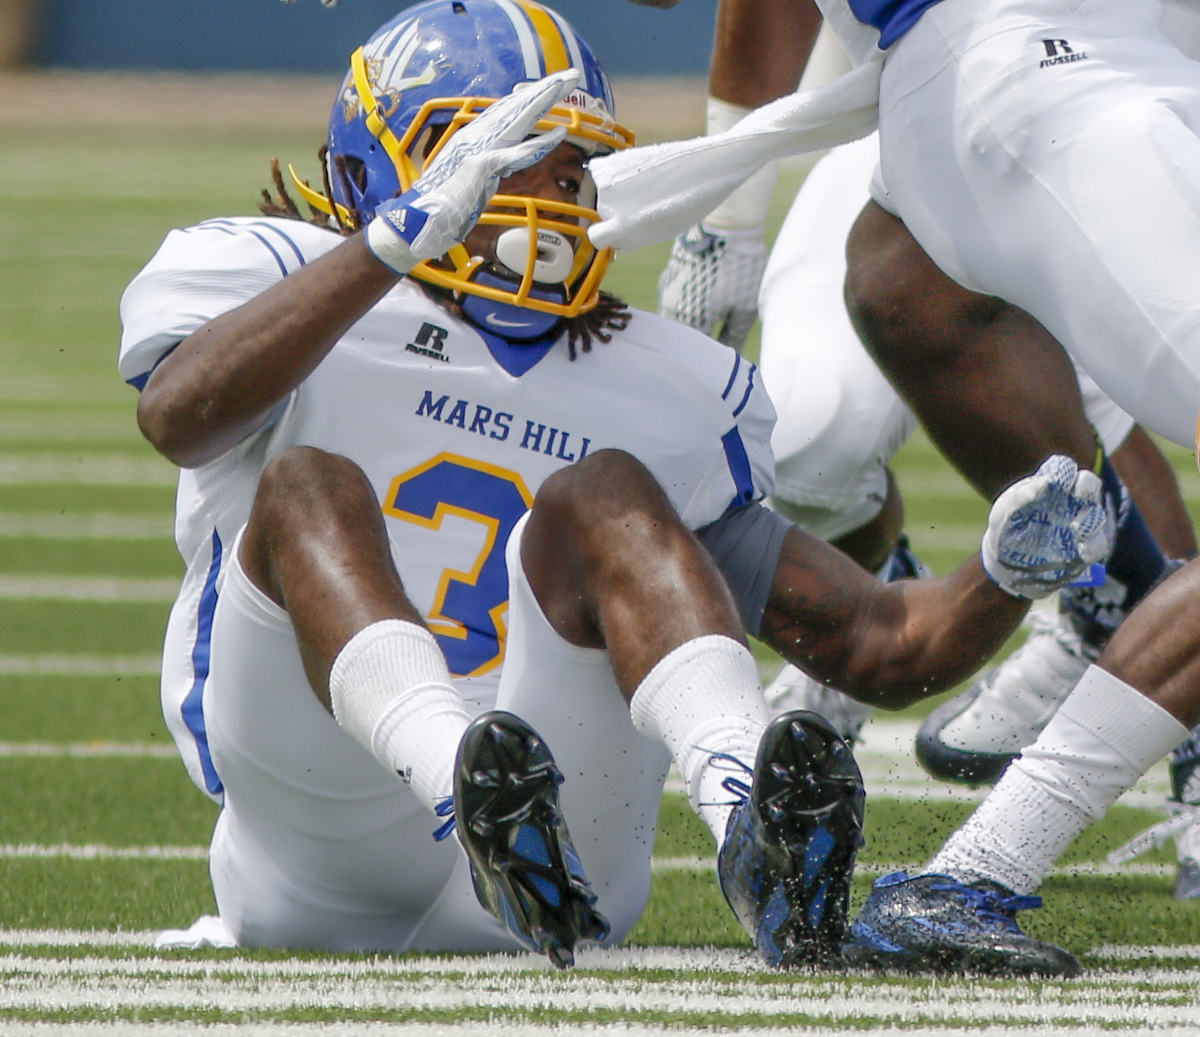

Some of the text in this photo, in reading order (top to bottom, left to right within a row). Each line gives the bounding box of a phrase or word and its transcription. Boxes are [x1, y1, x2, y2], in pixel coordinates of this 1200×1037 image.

[1039, 51, 1088, 69] RUSSELL
[404, 342, 451, 364] RUSSELL
[415, 389, 515, 443] MARS
[380, 450, 536, 679] 3
